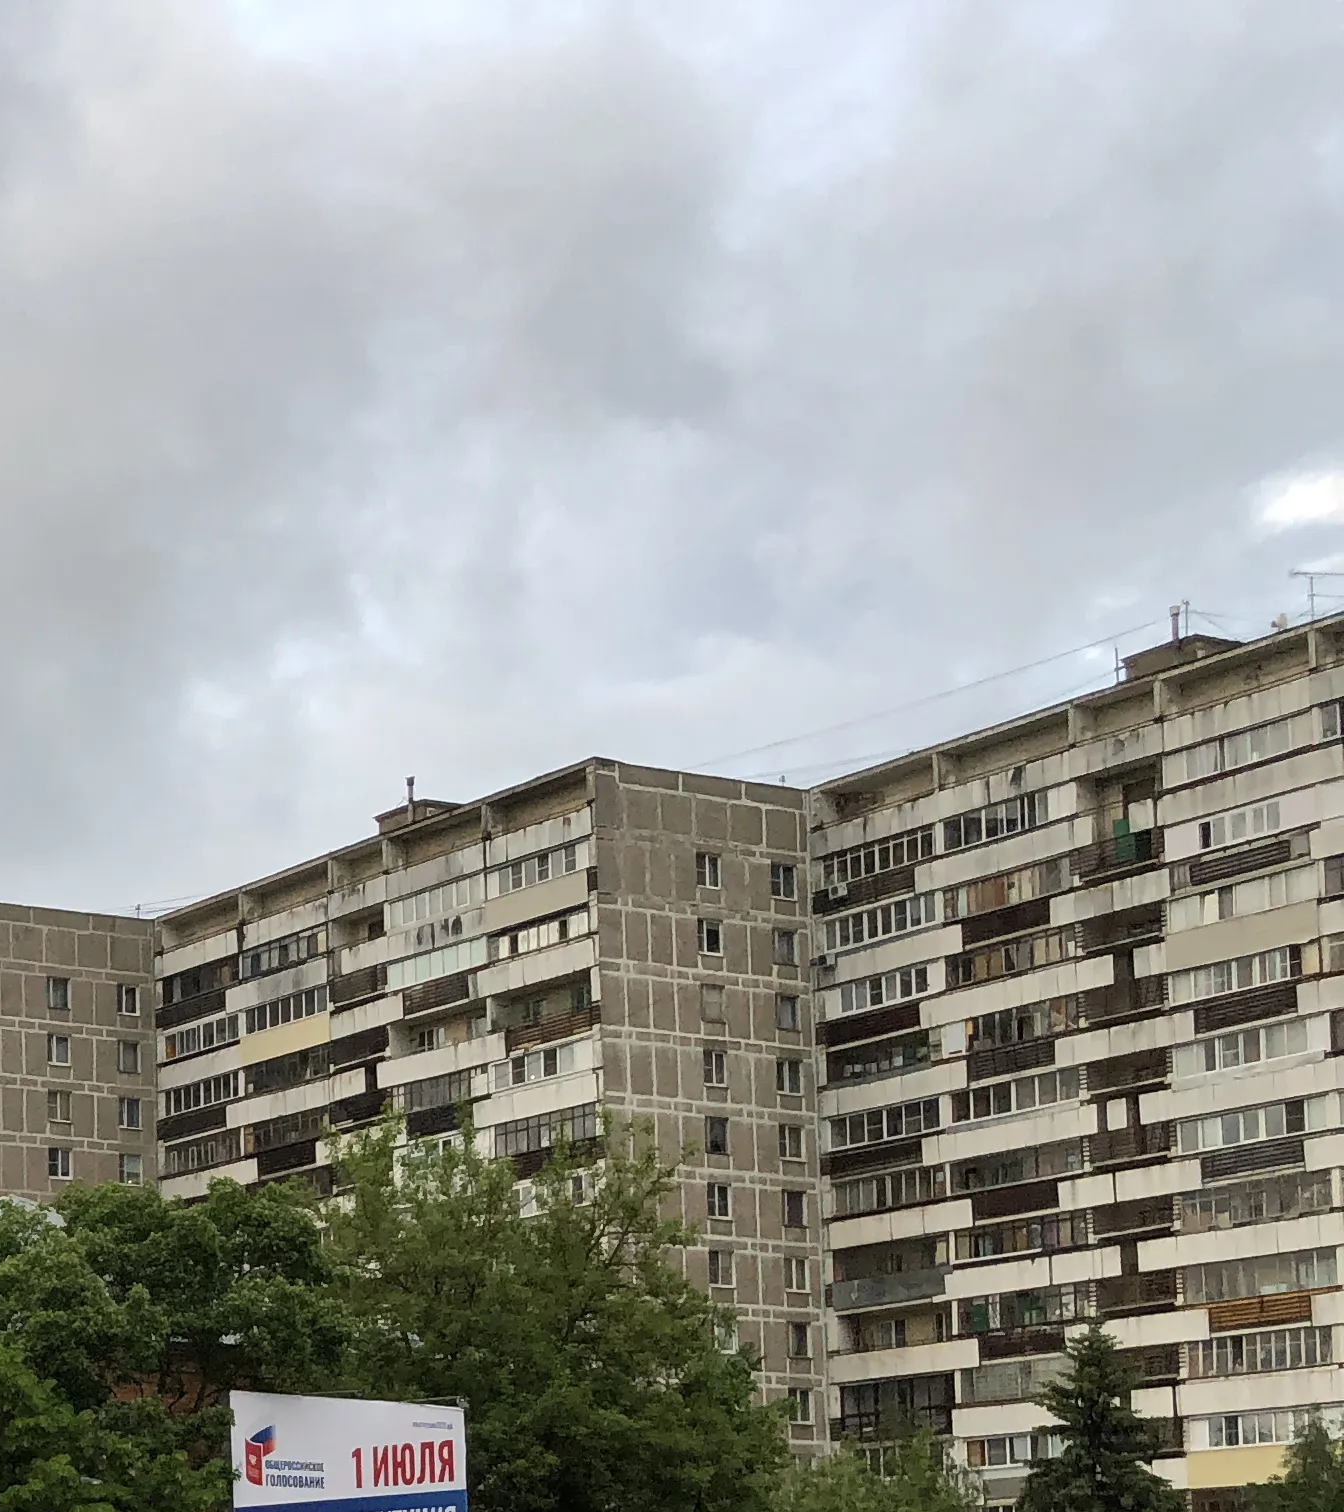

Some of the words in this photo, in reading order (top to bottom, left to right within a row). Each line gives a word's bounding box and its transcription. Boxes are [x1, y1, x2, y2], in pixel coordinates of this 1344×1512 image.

[352, 1448, 362, 1489] 1
[373, 1439, 455, 1488] ИЮЛЯ
[265, 1473, 325, 1489] ГОЛОСОВАНИЕ
